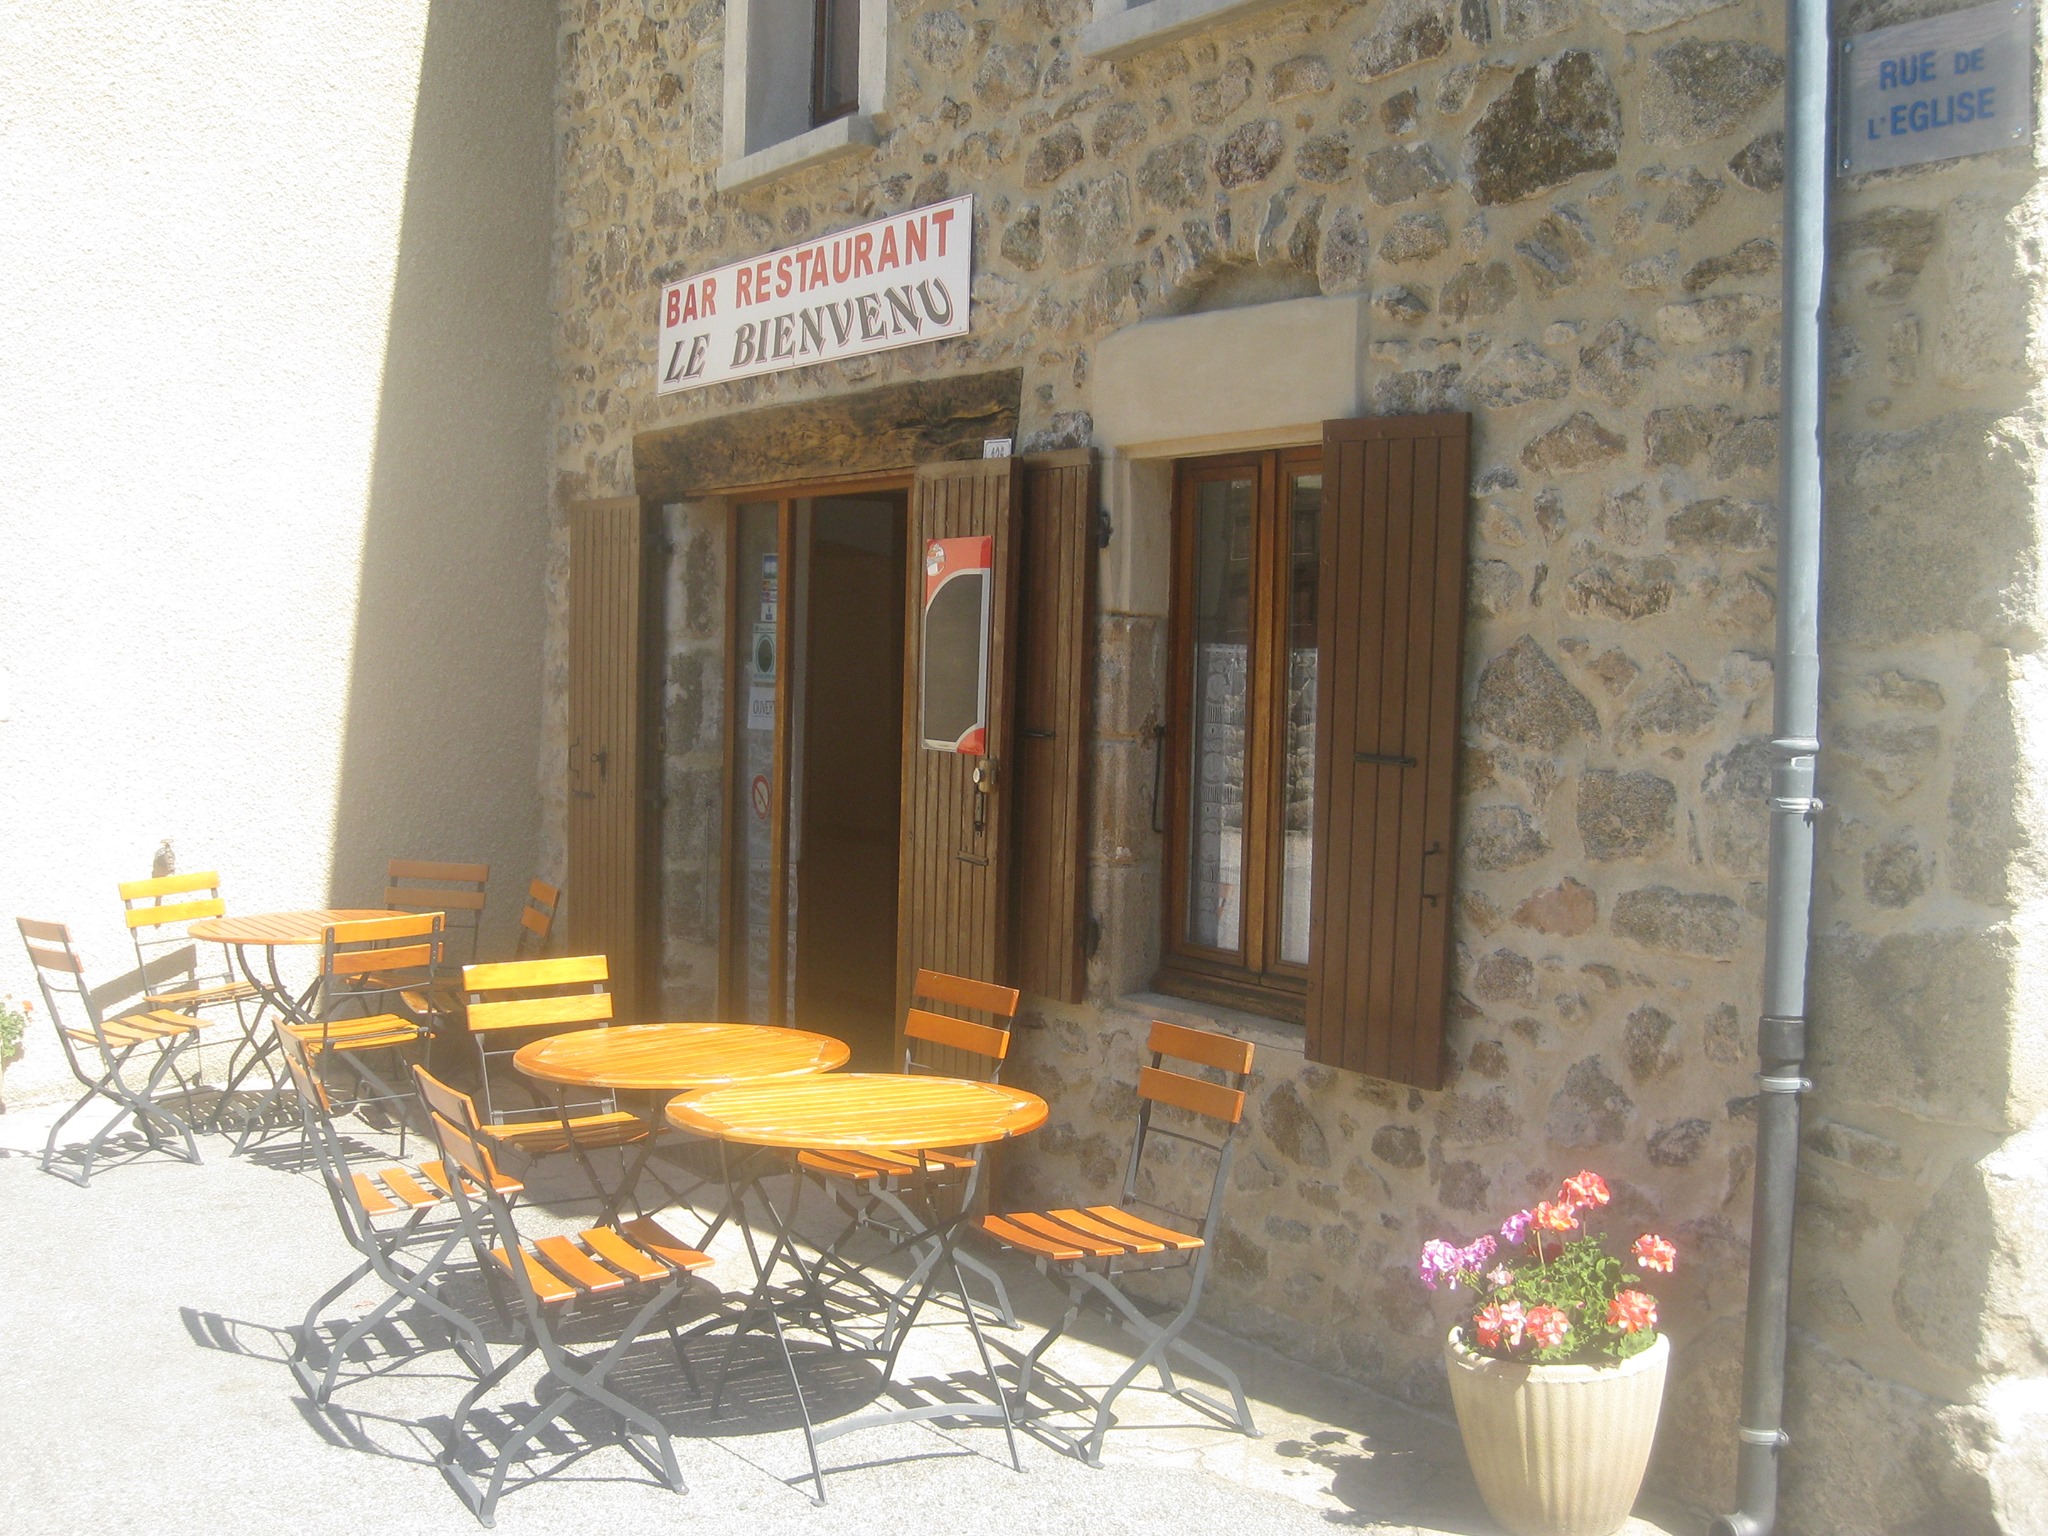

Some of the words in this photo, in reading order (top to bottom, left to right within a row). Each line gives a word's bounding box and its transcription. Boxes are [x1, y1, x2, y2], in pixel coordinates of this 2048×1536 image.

[1879, 50, 1937, 91] RUE
[1953, 48, 1985, 75] DE
[1867, 87, 1996, 140] L'EGLISE
[666, 277, 717, 328] BAR
[735, 207, 954, 309] RESTAURANT
[663, 333, 711, 383] LE
[729, 277, 954, 369] BIENVENU
